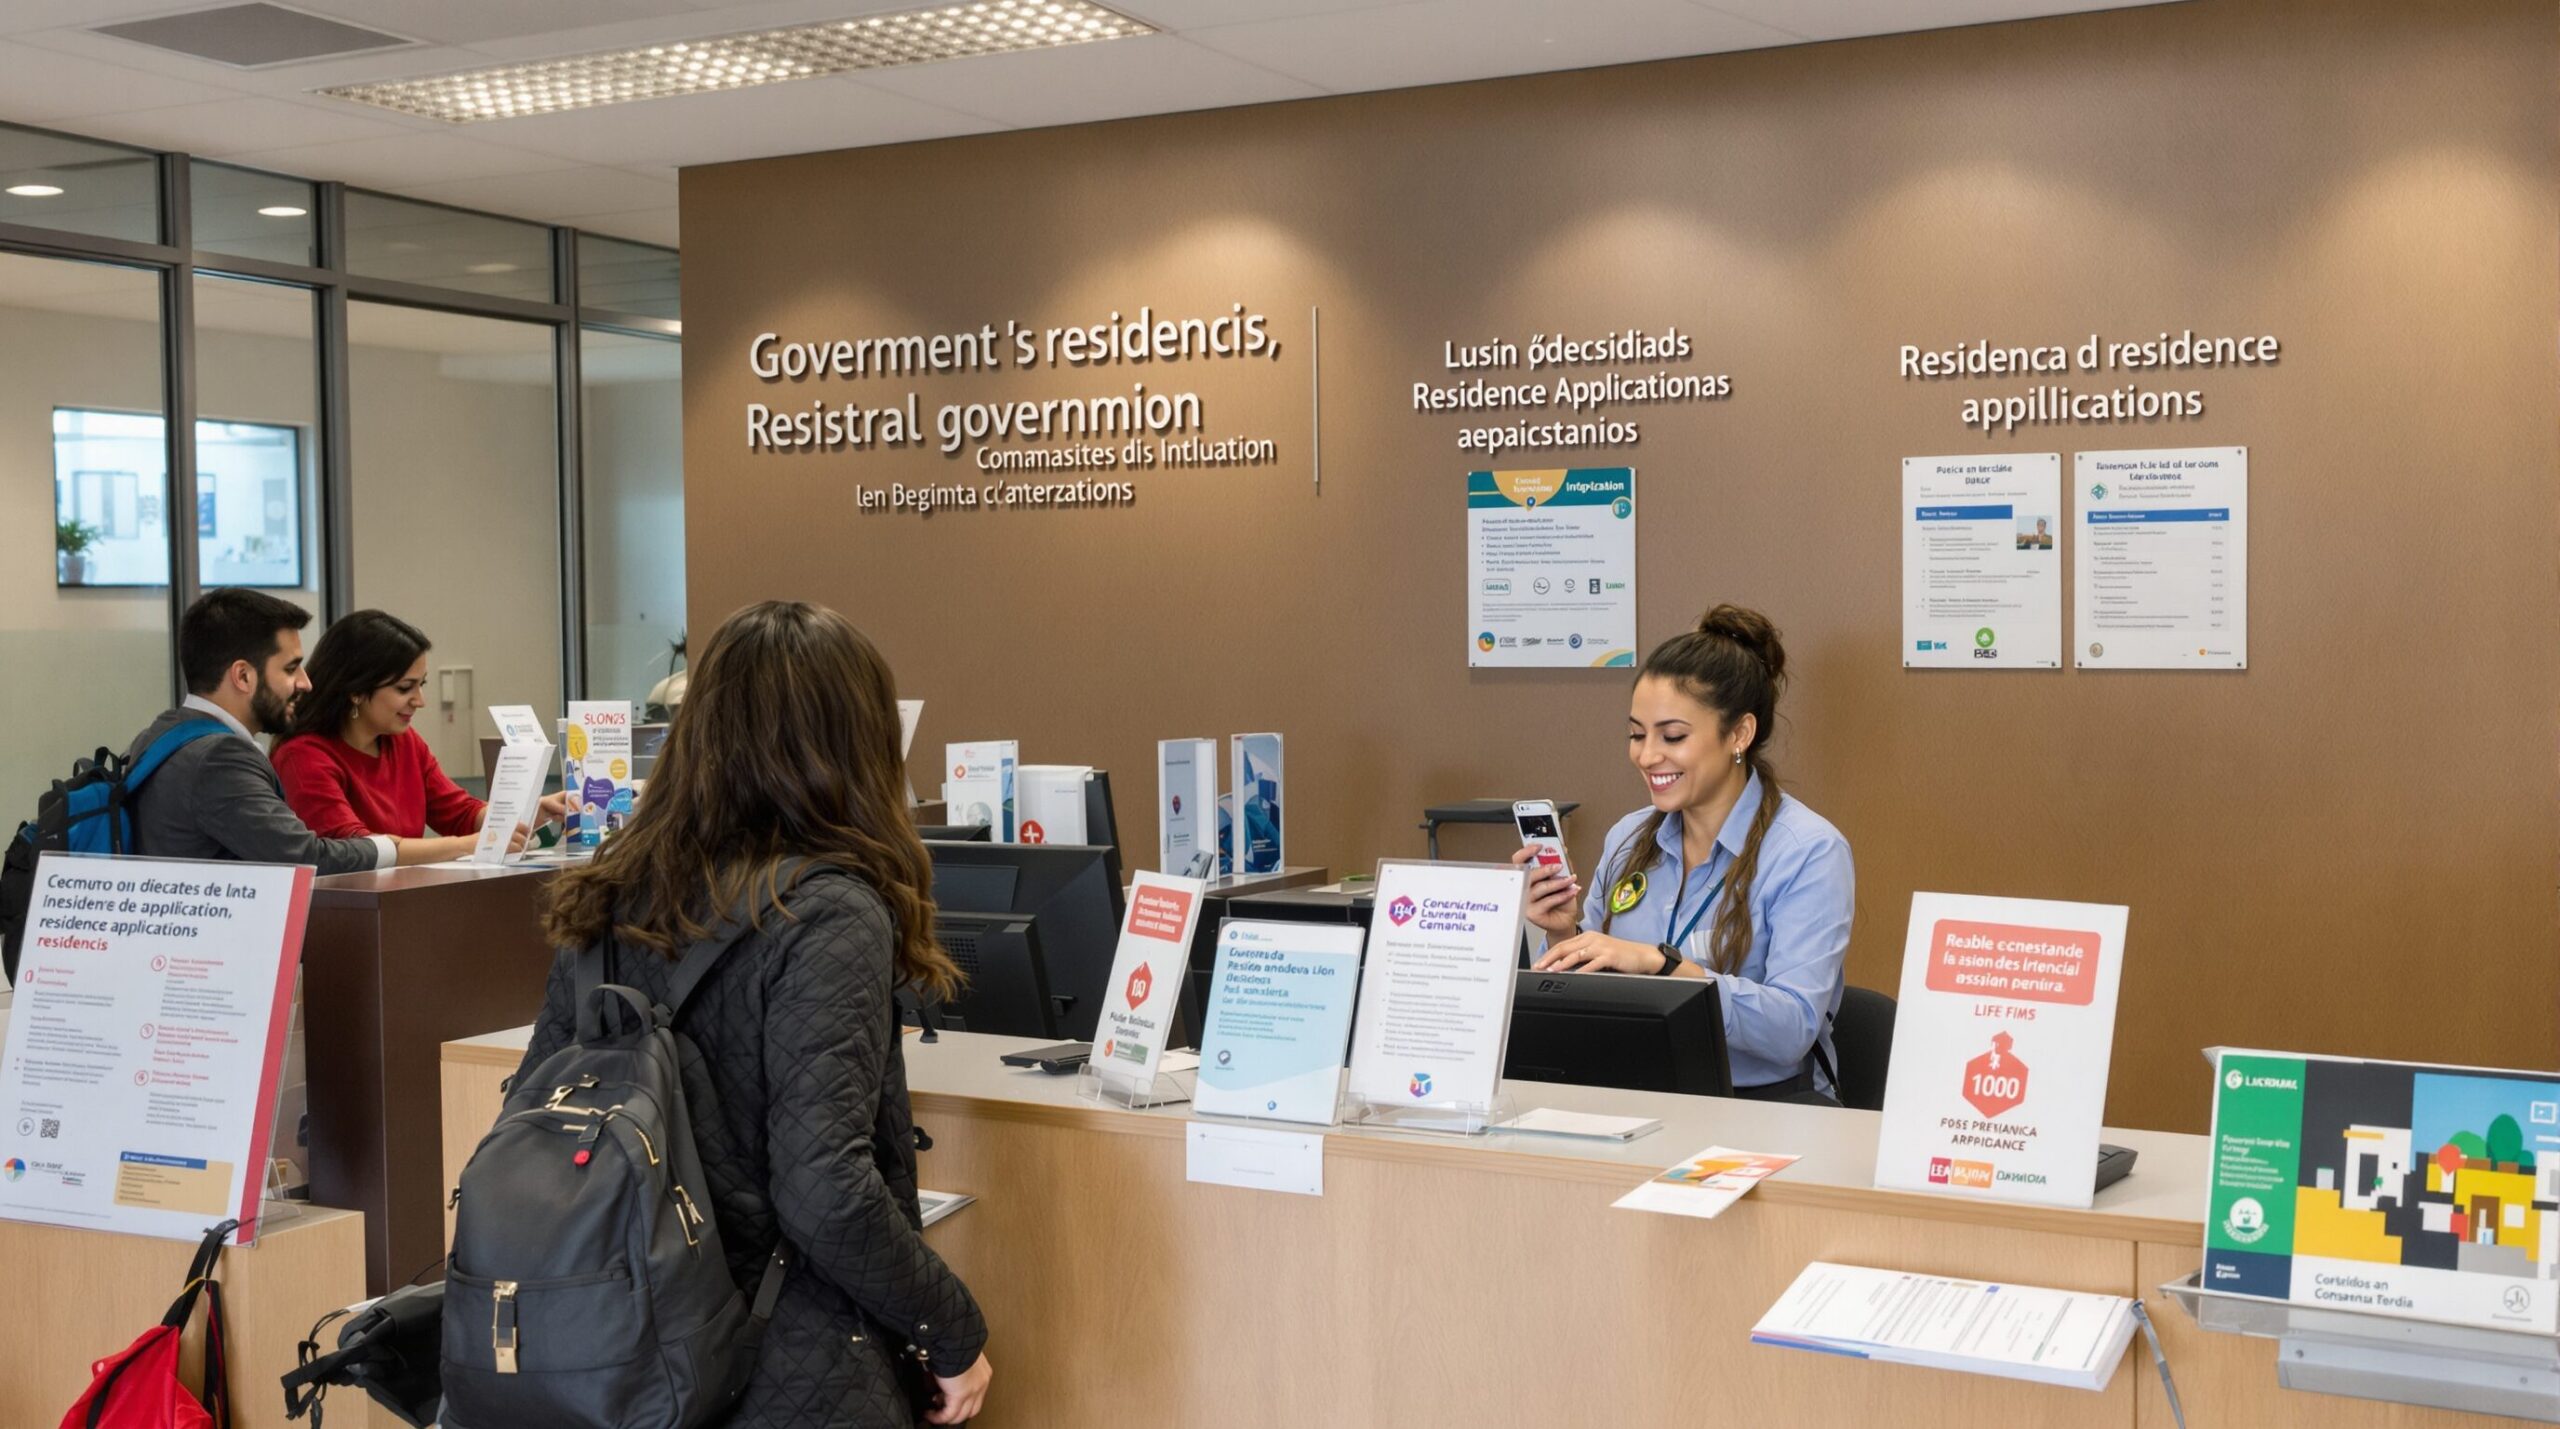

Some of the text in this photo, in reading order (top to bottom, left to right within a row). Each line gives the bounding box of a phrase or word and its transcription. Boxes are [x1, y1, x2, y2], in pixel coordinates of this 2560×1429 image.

[1046, 302, 1281, 362] residencis,
[1444, 337, 1518, 368] Lusin
[1899, 329, 2279, 377] Residenca d residence
[1412, 371, 1731, 410] Residence Applicationas
[746, 392, 922, 448] Resistral
[1960, 384, 2203, 430] appillications
[1457, 416, 1639, 455] aepaicstanios
[118, 897, 137, 913] de
[203, 881, 222, 898] de
[39, 914, 199, 938] residence applications
[36, 933, 109, 951] residencis
[1974, 1003, 2002, 1018] LIFE
[1971, 1073, 2021, 1100] 1000
